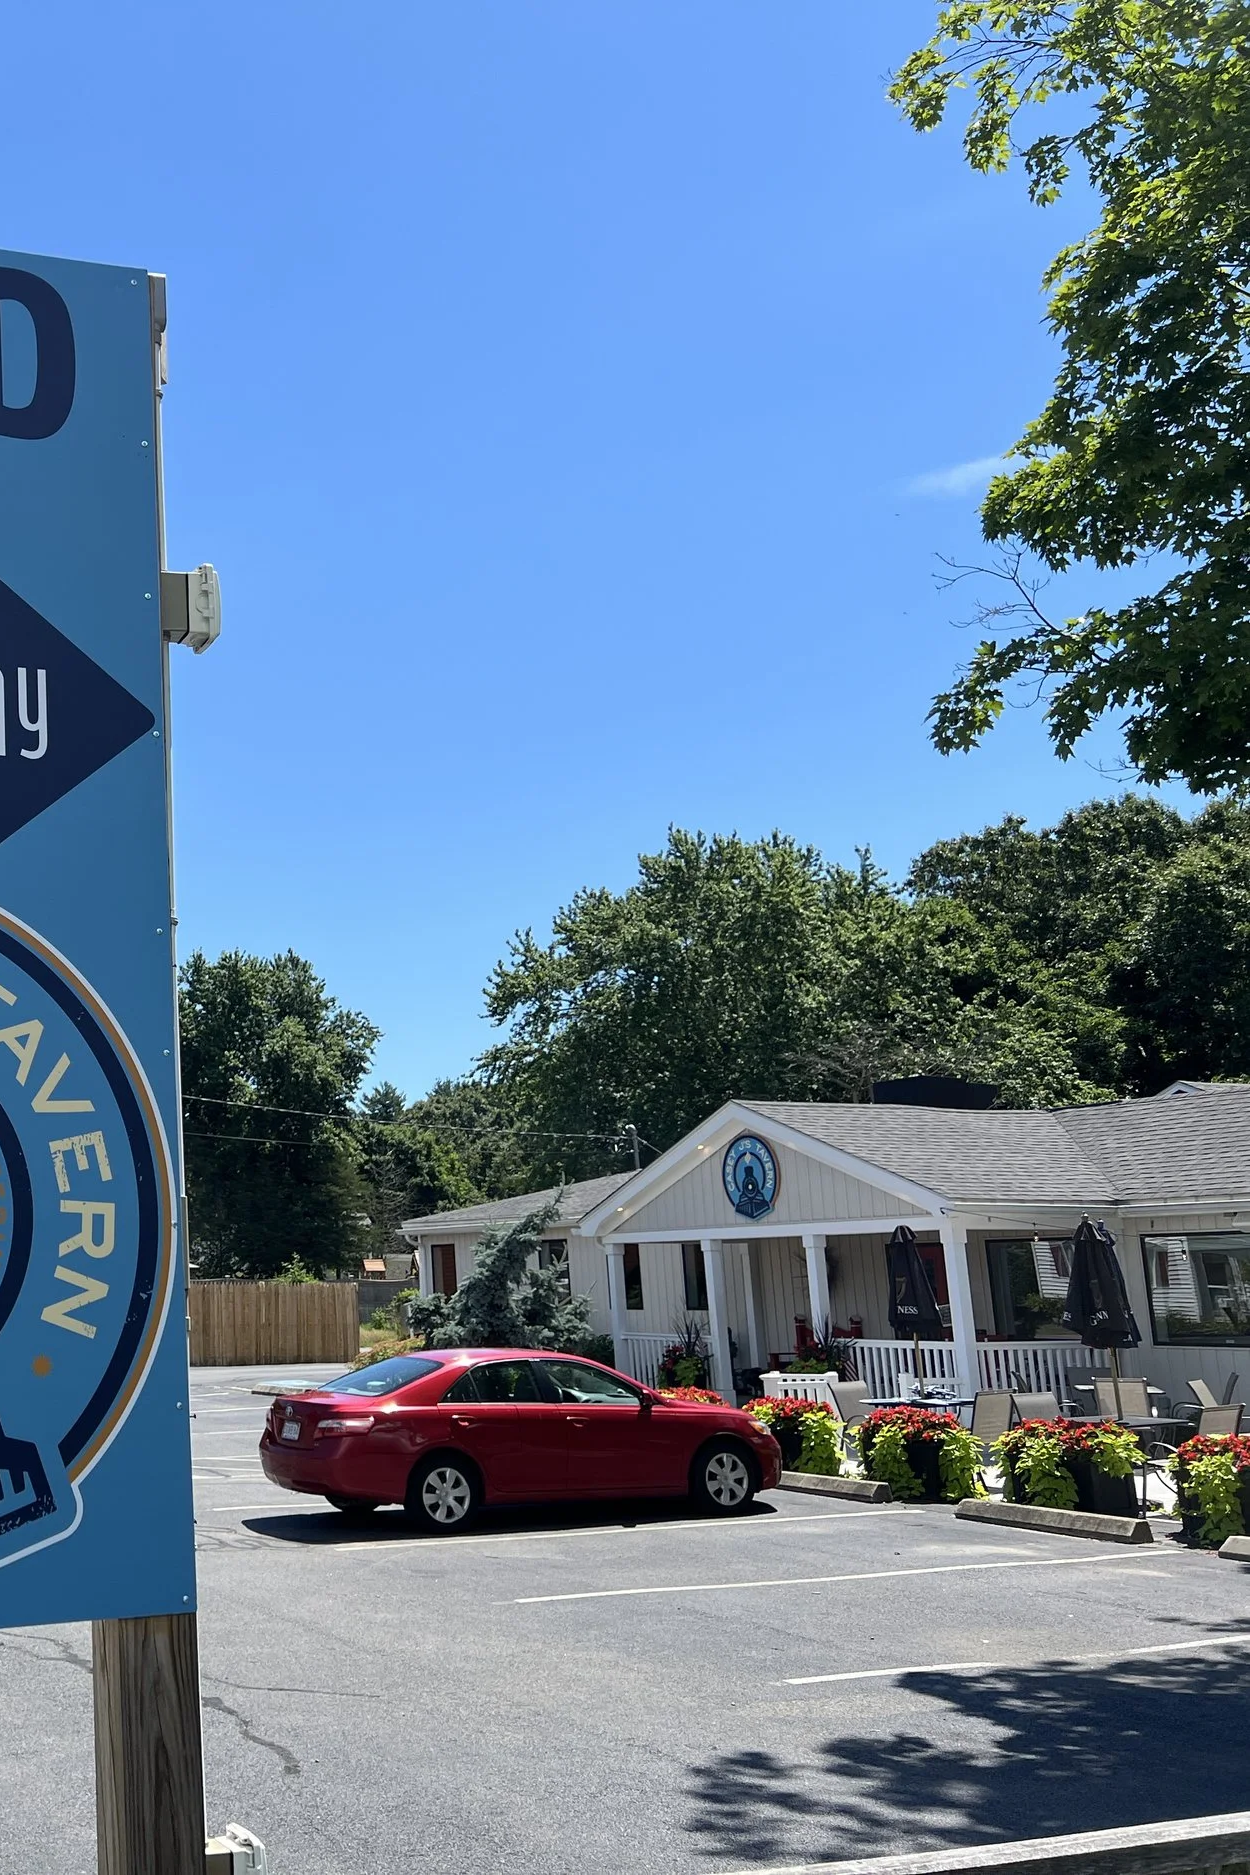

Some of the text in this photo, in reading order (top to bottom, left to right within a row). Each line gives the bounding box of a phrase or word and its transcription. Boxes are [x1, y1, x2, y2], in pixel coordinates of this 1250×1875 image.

[726, 1140, 774, 1191] CASEY J'S TAVERN
[896, 1305, 918, 1314] NESS
